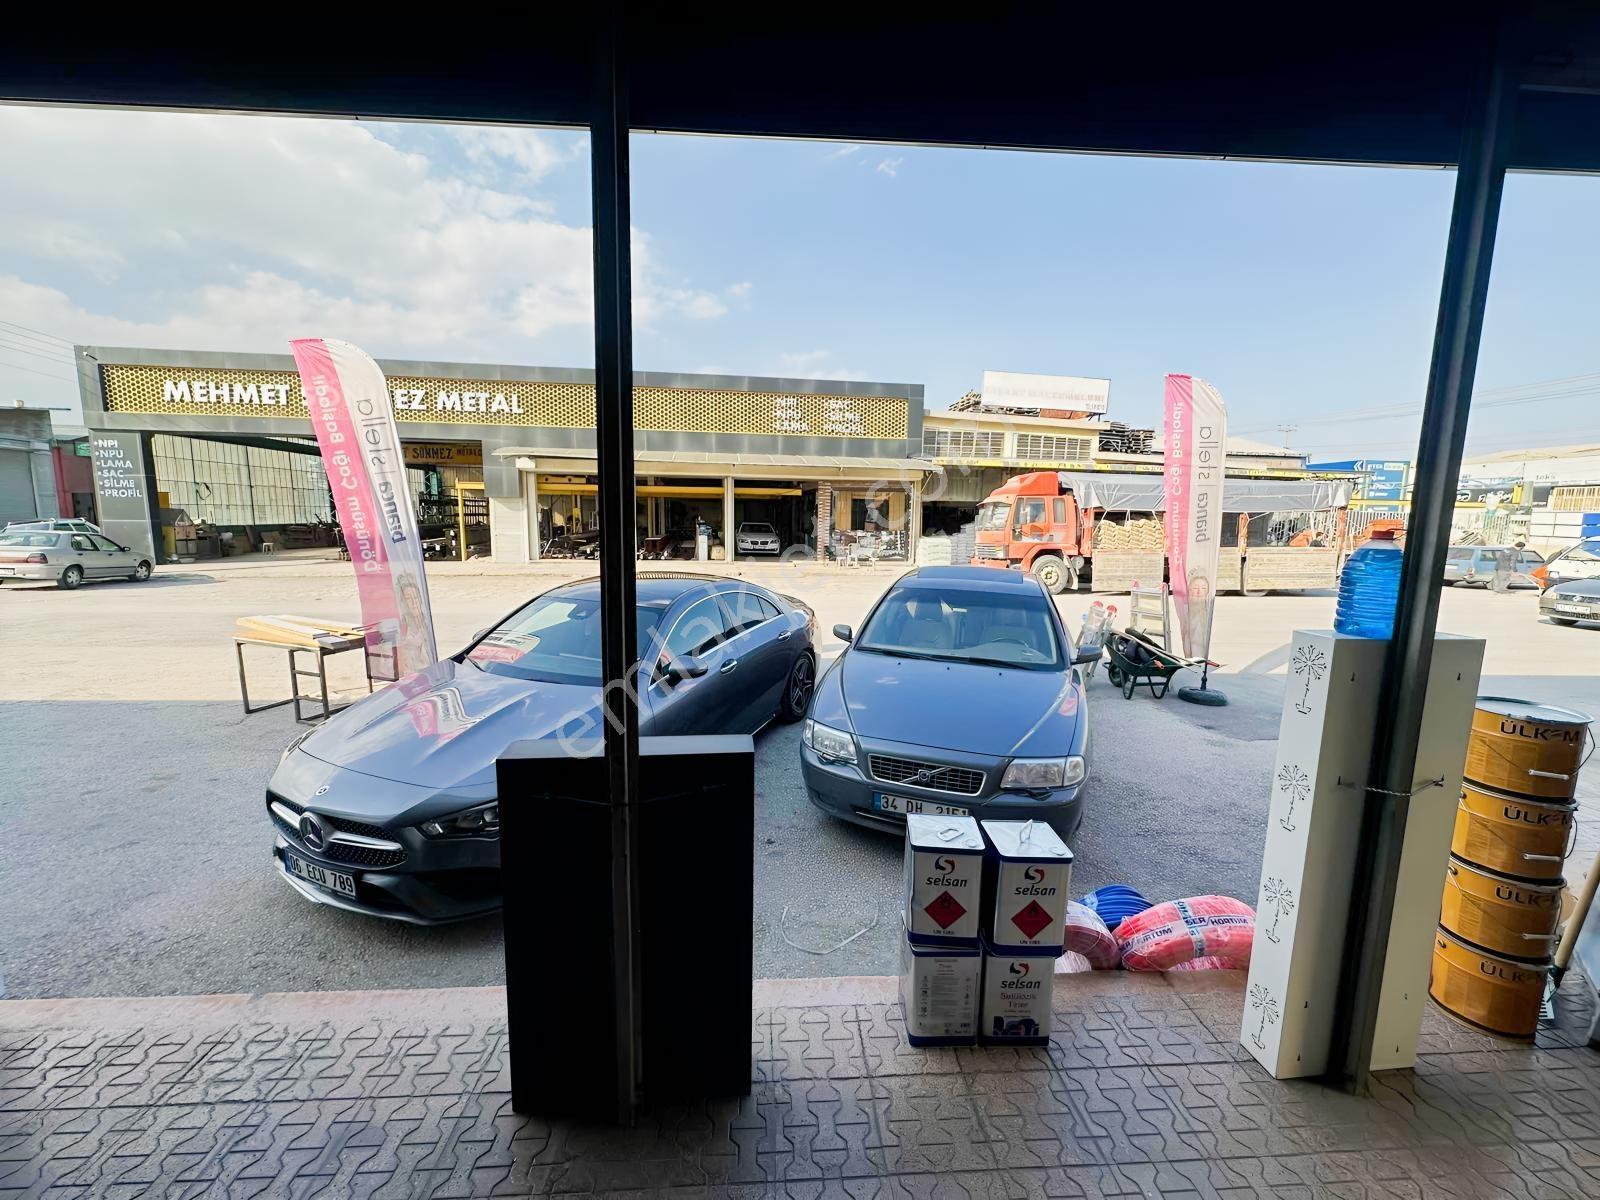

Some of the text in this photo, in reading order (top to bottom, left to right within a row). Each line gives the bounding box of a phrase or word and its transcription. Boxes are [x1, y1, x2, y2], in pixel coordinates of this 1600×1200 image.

[163, 379, 290, 406] MEHMET
[437, 390, 525, 414] METAL
[97, 439, 118, 448] NPI
[99, 449, 124, 458] NPU
[101, 459, 133, 469] LAMA
[102, 469, 124, 478] SAC
[881, 795, 899, 811] 34
[906, 800, 923, 813] DH
[289, 853, 354, 893] 06 ECU 789
[925, 873, 968, 888] selsan
[1014, 884, 1056, 896] selsan
[1001, 978, 1041, 990] selsan
